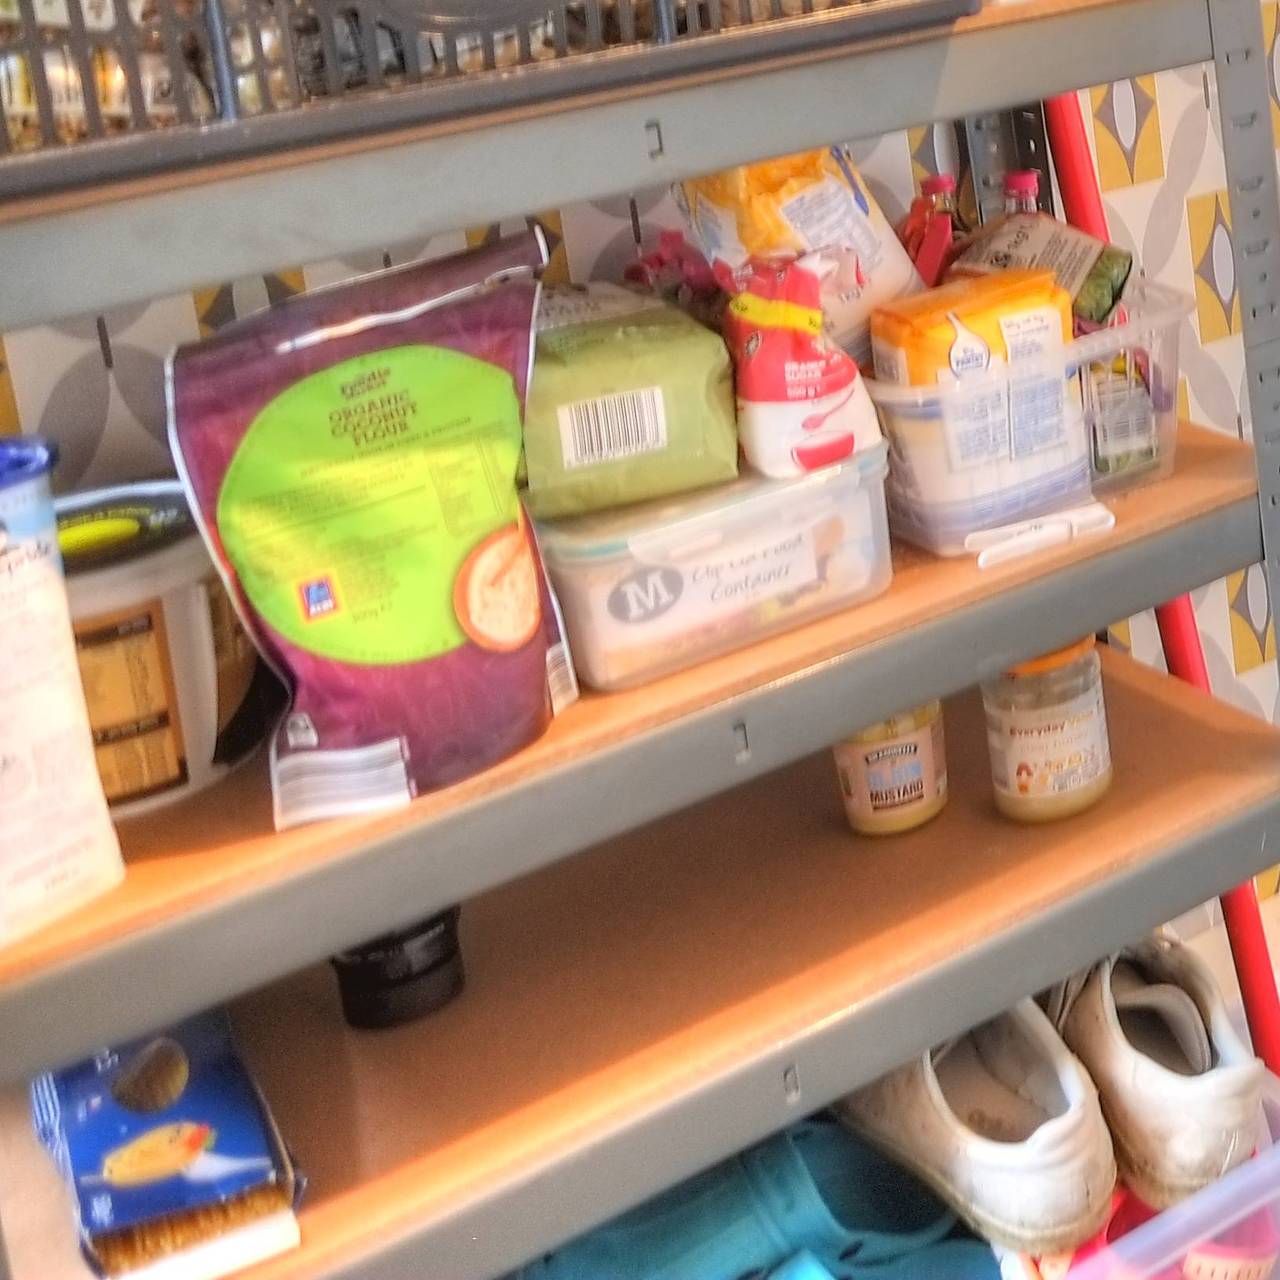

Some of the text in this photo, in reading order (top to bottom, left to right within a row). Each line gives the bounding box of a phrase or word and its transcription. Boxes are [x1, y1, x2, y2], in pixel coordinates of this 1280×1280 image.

[329, 389, 410, 422] ORGANIC
[331, 401, 418, 438] COCONUT
[353, 421, 409, 448] FLOUR
[621, 570, 676, 621] M
[870, 779, 924, 805] MUSTARD
